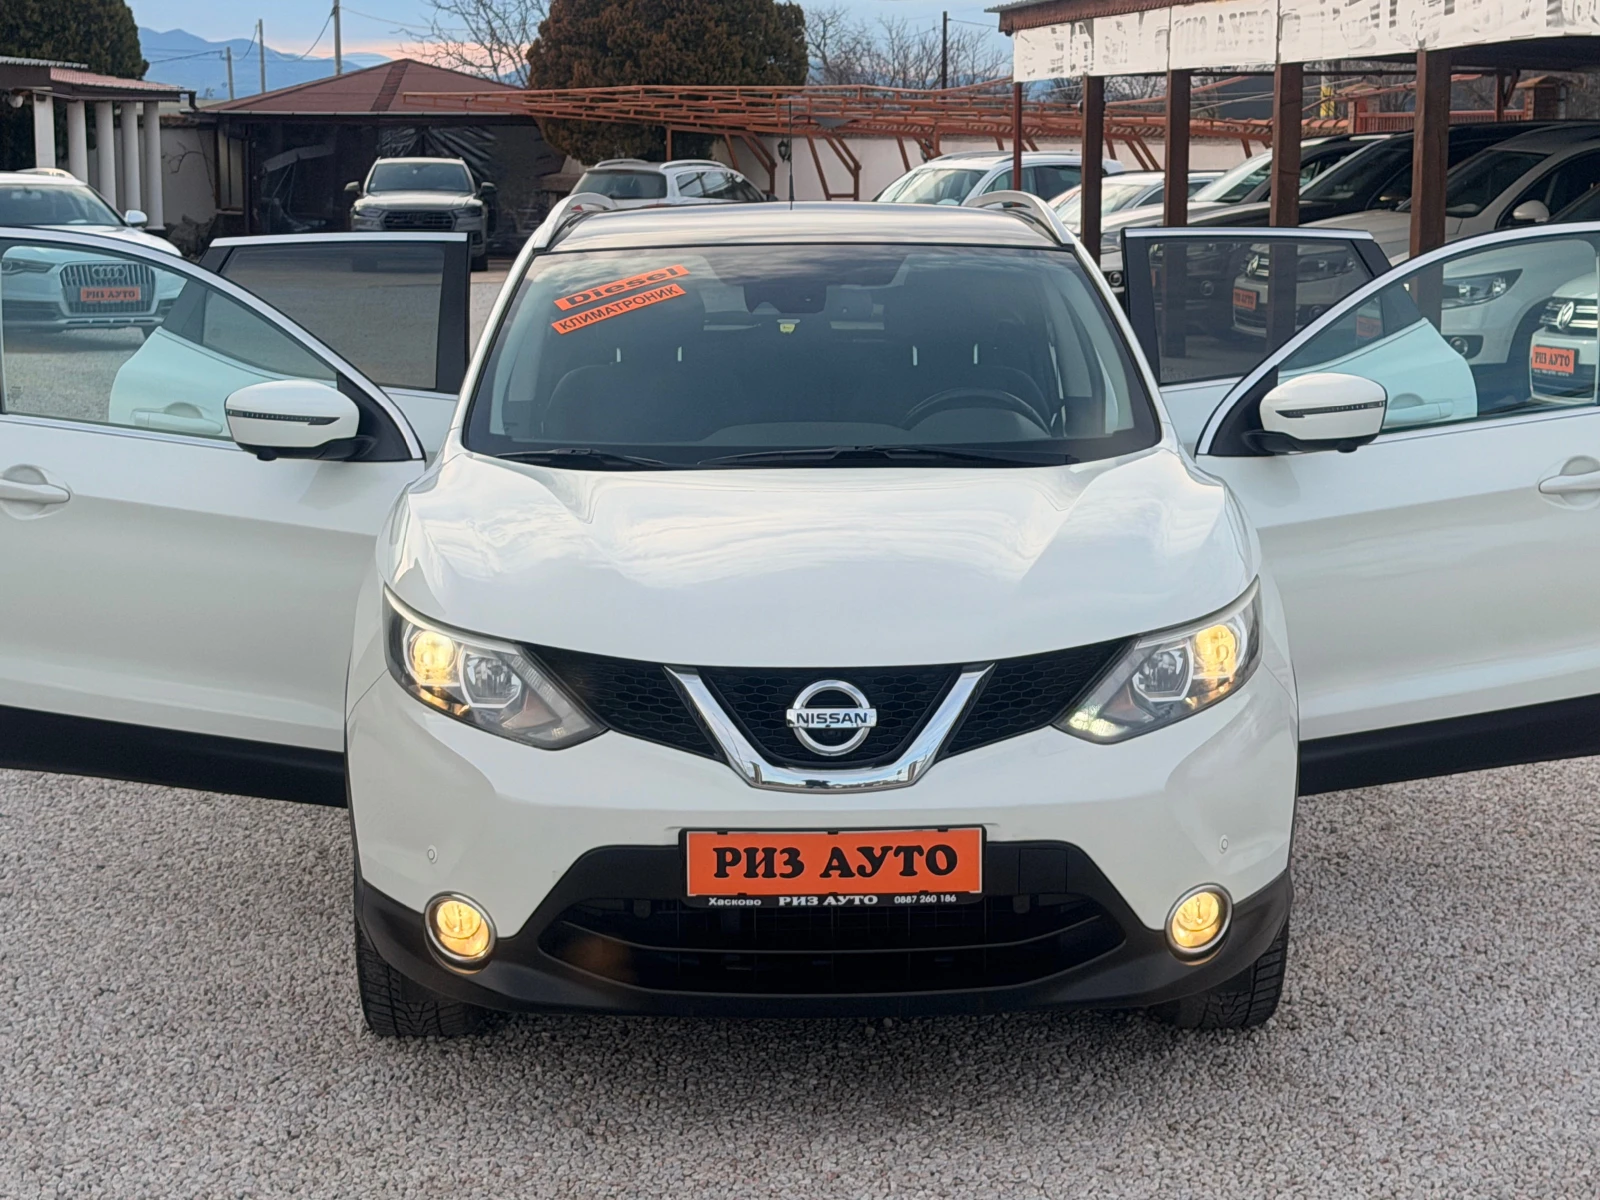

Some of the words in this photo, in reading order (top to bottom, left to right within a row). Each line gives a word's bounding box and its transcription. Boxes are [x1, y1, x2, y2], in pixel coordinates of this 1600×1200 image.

[565, 267, 679, 306] Diesel
[559, 286, 679, 330] КЛИМАТРОНИК
[796, 712, 868, 724] NISSAN
[712, 846, 805, 879] РИЗ
[819, 844, 958, 878] АУТО
[708, 896, 762, 906] Хасково
[778, 896, 819, 906] РИЗ
[822, 895, 878, 906] АУТО
[894, 895, 917, 904] 0887
[919, 894, 938, 903] 260
[940, 894, 957, 903] 186
